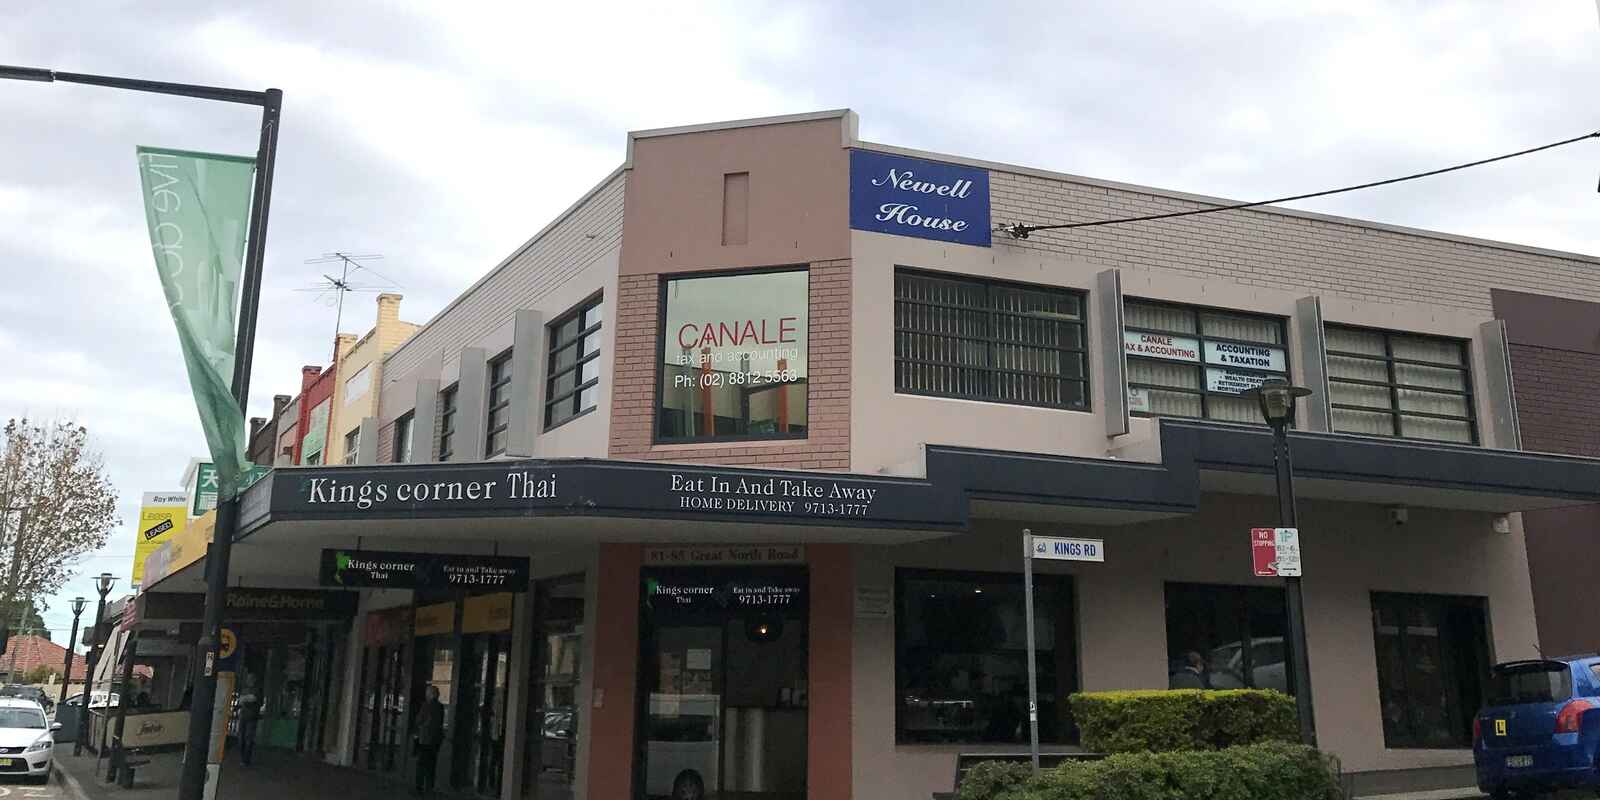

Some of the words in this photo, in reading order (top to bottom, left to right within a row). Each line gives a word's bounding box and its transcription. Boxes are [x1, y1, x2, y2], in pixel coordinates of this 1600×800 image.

[871, 168, 973, 199] Newell
[875, 203, 969, 232] House
[678, 317, 797, 349] CANALE
[1141, 335, 1172, 346] CANALE
[676, 353, 695, 366] tax
[699, 350, 722, 364] and
[727, 347, 798, 362] accounting
[1125, 343, 1136, 352] AX
[1144, 346, 1195, 359] ACCOUNTING
[1216, 344, 1271, 357] ACCOUNTING
[1220, 354, 1227, 362] &
[1229, 355, 1270, 367] TAXATION
[674, 374, 695, 388] Ph:
[700, 373, 725, 389] (02)
[728, 371, 761, 385] 8812
[765, 370, 798, 383] 5563
[308, 478, 388, 509] Kings
[396, 479, 497, 501] corner
[507, 472, 557, 499] Thai
[671, 474, 704, 492] Eat
[711, 476, 730, 493] In
[736, 477, 774, 496] And
[780, 480, 824, 498] Take
[829, 483, 877, 504] Away
[680, 496, 722, 509] HOME
[727, 498, 796, 512] DELIVERY
[804, 502, 868, 516] 9713-1777
[1258, 531, 1269, 539] NO
[690, 550, 723, 562] Great
[729, 548, 762, 560] North
[768, 548, 798, 560] Road
[1054, 541, 1081, 556] KINGS
[1083, 544, 1096, 557] RD
[347, 559, 378, 571] Kings
[380, 561, 415, 571] corner
[465, 566, 479, 574] and
[370, 571, 389, 580] Thai
[449, 574, 505, 585] 9713-1777
[656, 584, 681, 595] Kings
[683, 585, 714, 594] corner
[753, 586, 766, 594] and
[739, 594, 791, 605] 9713-1777
[1497, 721, 1504, 734] L
